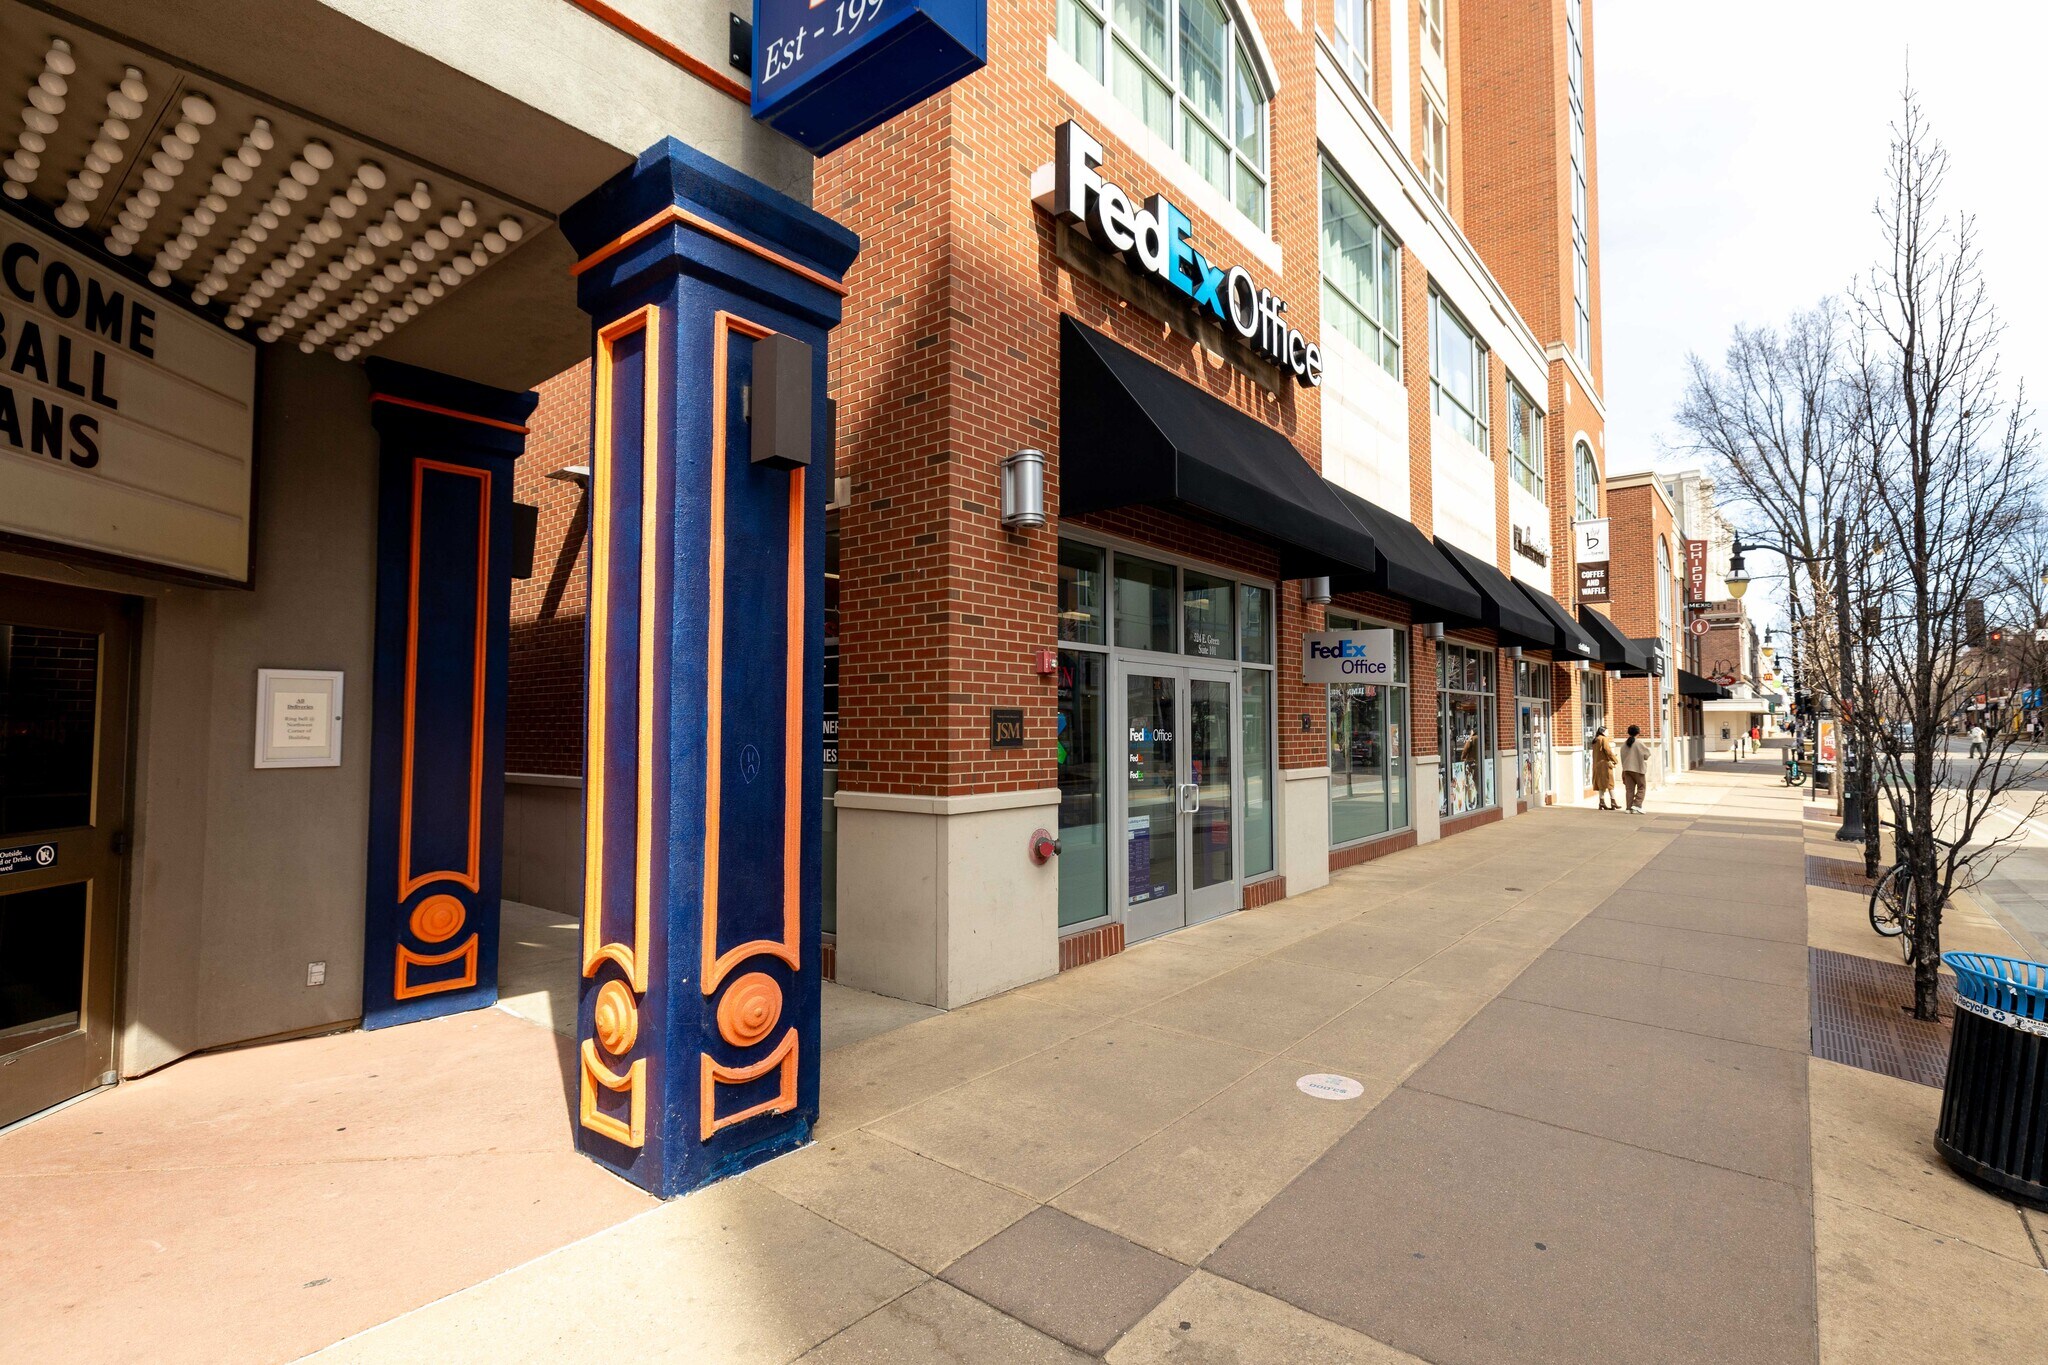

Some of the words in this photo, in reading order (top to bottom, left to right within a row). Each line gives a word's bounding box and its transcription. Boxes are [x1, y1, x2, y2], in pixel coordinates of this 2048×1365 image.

[761, 26, 807, 85] Est
[1056, 118, 1226, 321] FedEx
[1226, 265, 1323, 389] Office
[2, 242, 156, 359] COME
[0, 310, 119, 411] ALL
[1581, 570, 1605, 578] COFFEE
[1689, 542, 1703, 600] CHIPOTLE
[1581, 587, 1606, 596] WAFFLE
[1586, 579, 1600, 587] AND
[1310, 639, 1367, 659] FedEx
[1341, 659, 1387, 675] Office
[995, 722, 1021, 742] JSM
[1129, 727, 1153, 742] FedEx
[1152, 728, 1173, 742] Office
[12, 855, 32, 863] Drinks
[1957, 995, 1990, 1016] Recycle
